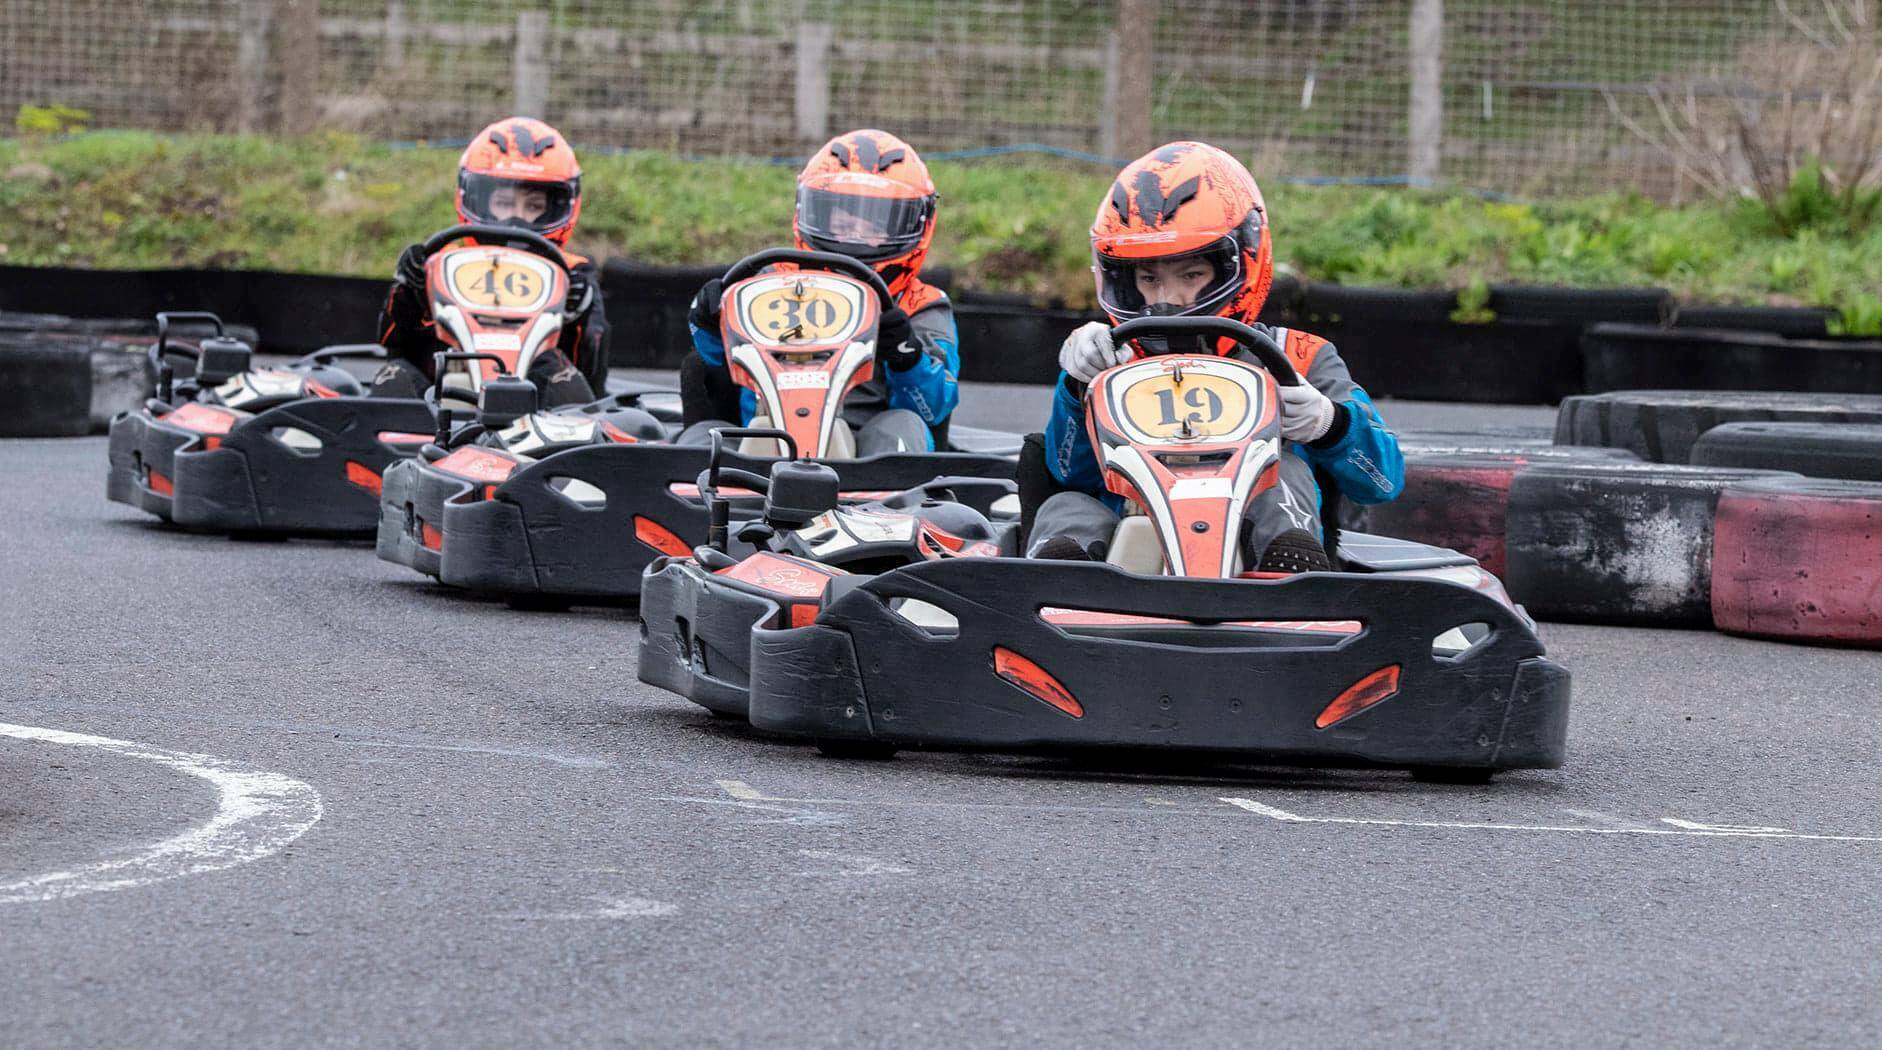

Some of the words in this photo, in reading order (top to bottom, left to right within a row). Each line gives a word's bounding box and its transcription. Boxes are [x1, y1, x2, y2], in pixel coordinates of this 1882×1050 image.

[468, 270, 531, 297] 46
[768, 299, 837, 330] 30
[1153, 387, 1224, 426] 19
